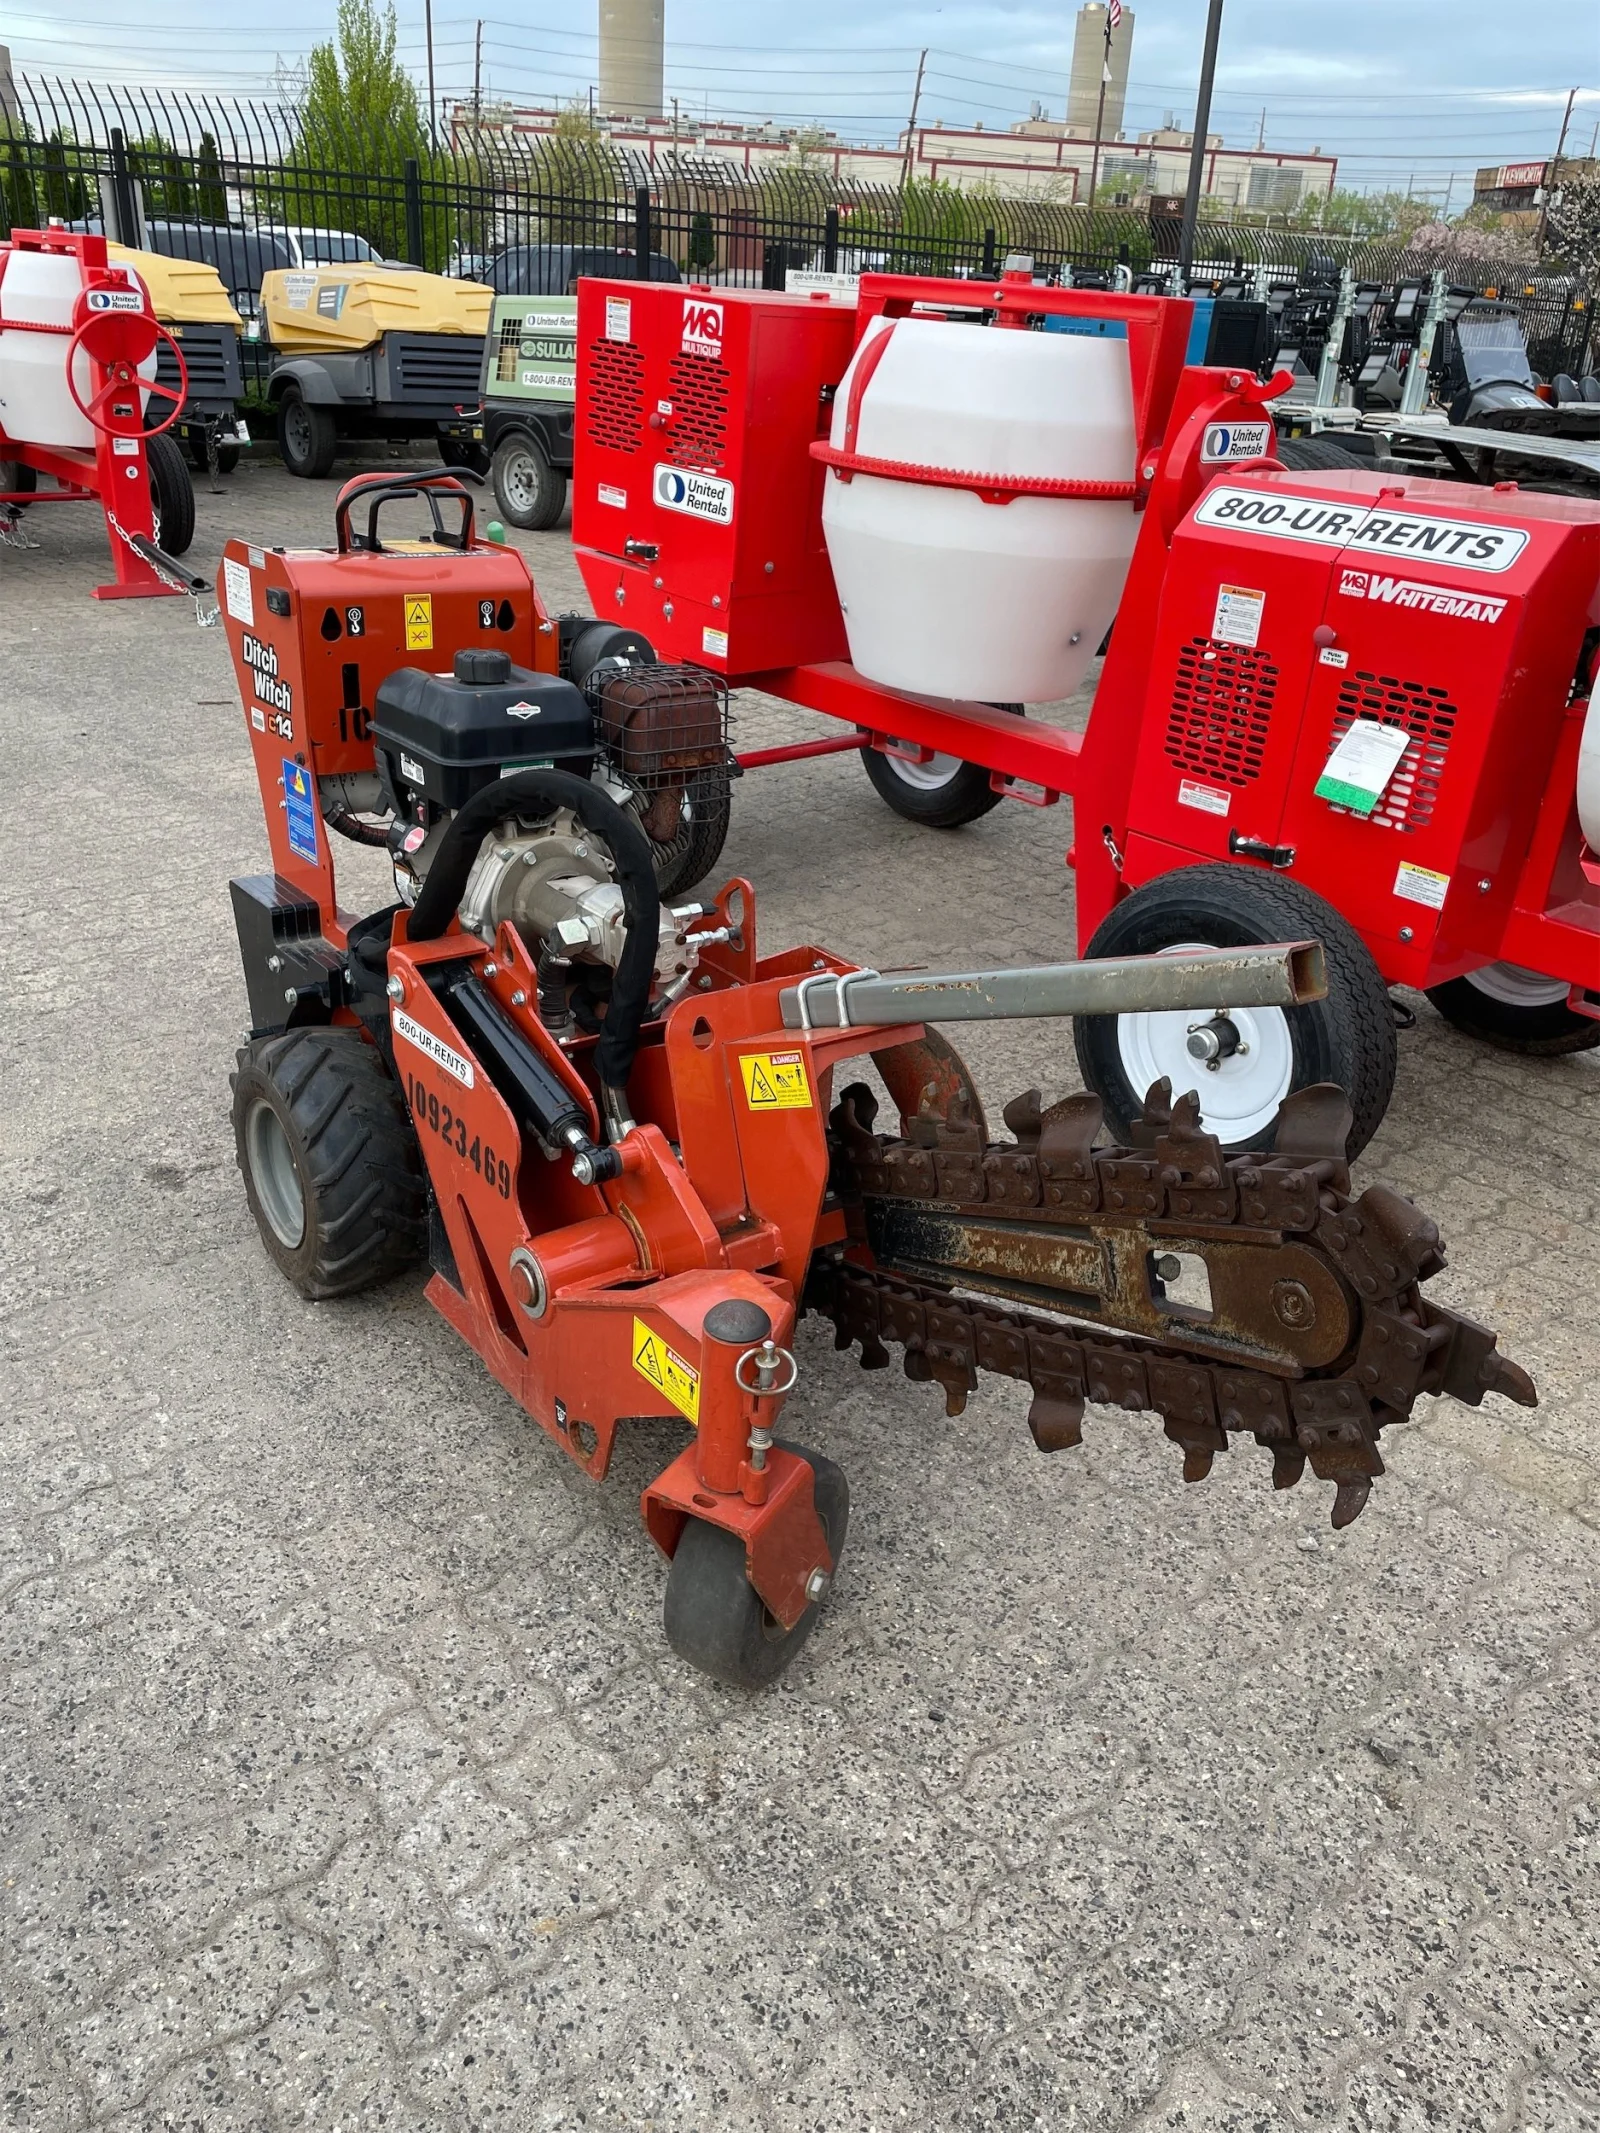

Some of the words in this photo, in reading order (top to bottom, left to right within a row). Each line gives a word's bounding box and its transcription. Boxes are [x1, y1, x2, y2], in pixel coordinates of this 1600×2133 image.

[1505, 165, 1543, 184] KENWORTH
[112, 302, 140, 310] Rentals
[536, 316, 559, 326] United
[682, 305, 722, 341] MQ
[682, 341, 721, 359] MULTIQUIP
[1232, 429, 1264, 442] United
[1228, 443, 1263, 456] Rentals
[687, 478, 726, 501] United
[686, 493, 728, 517] Rentals
[1214, 497, 1504, 561] 800-UR-RENTS
[1341, 573, 1367, 589] MQ
[1368, 574, 1509, 624] WHITEMAN
[243, 634, 278, 676] Ditch
[1328, 651, 1342, 659] PUSH
[253, 669, 291, 713] Witch
[399, 1017, 467, 1079] 800-UR-RENTS
[776, 1054, 799, 1065] DANGER
[408, 1071, 511, 1200] 10923469
